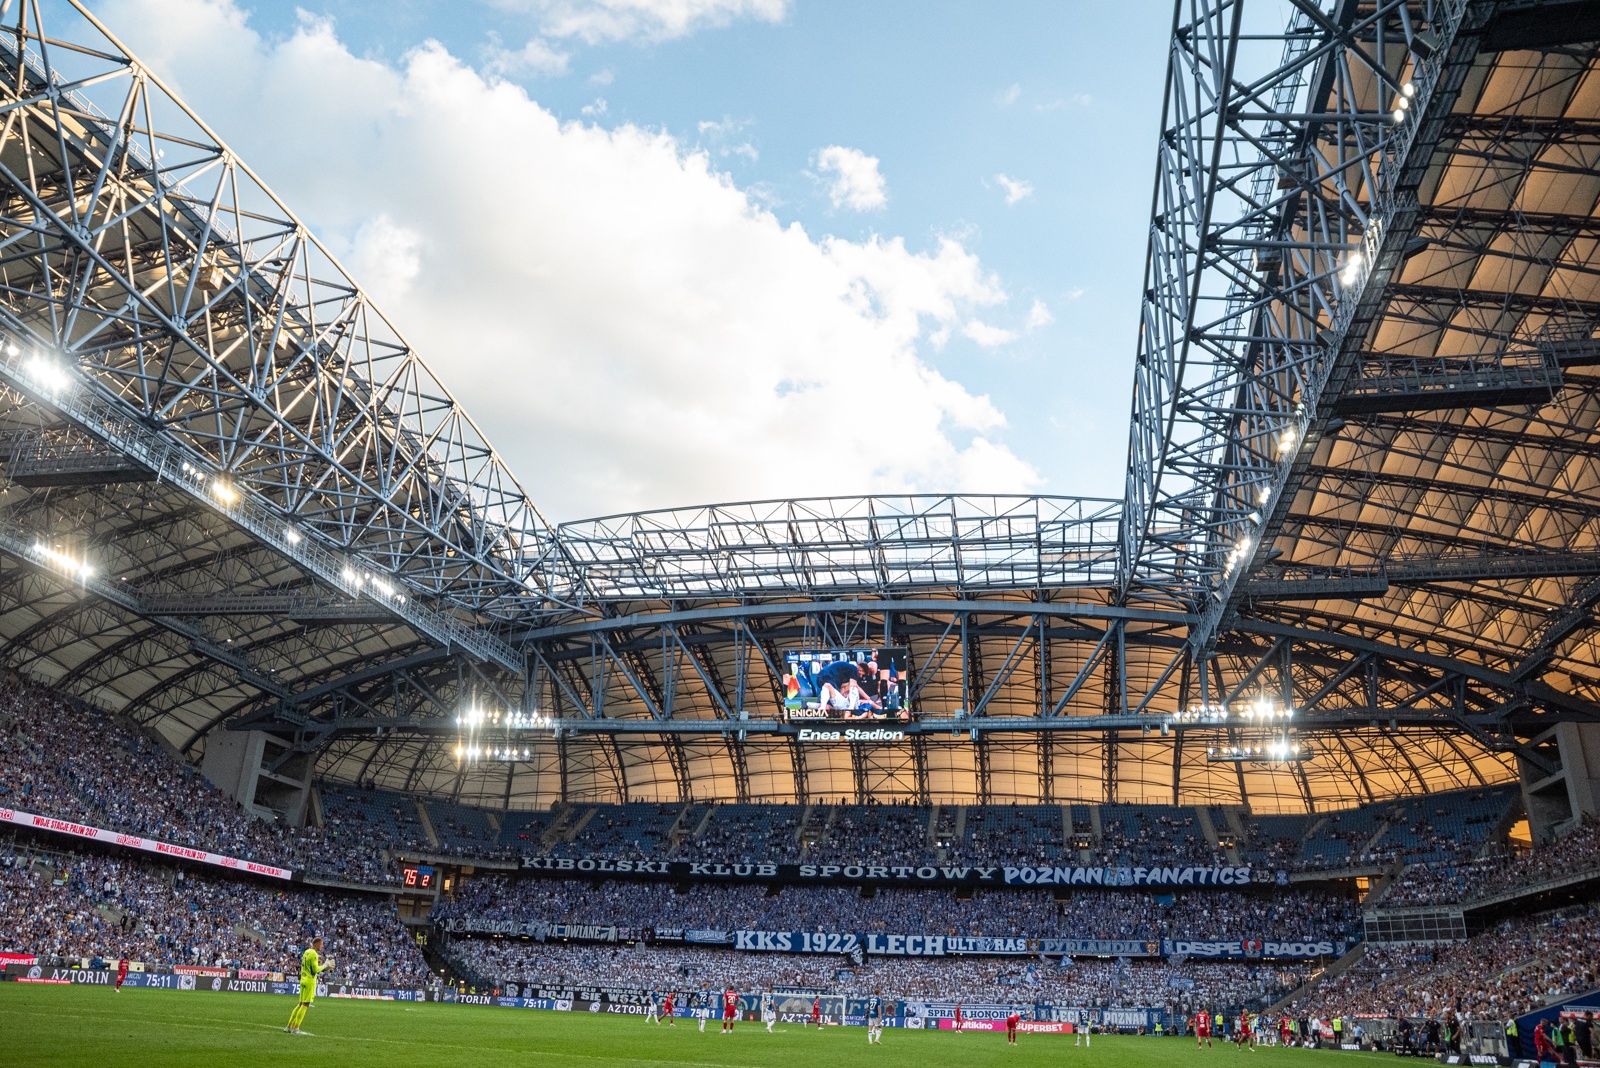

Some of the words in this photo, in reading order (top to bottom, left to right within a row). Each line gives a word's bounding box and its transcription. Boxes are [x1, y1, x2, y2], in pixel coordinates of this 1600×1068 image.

[790, 709, 828, 717] ENIGMA
[798, 729, 840, 740] Enea
[844, 729, 902, 740] Stadion
[86, 828, 98, 837] 24/7
[522, 856, 672, 873] KIBOLSKI
[689, 862, 778, 878] KLUB
[800, 864, 997, 880] SPORTOWY
[404, 868, 418, 885] 75
[422, 875, 430, 887] 2
[1003, 866, 1103, 884] POZNAN
[1133, 866, 1253, 885] FANATICS
[736, 930, 792, 952] KKS
[802, 932, 857, 953] 1922
[867, 934, 945, 955] LECH
[1044, 939, 1142, 954] PYRLANDIA
[1176, 942, 1241, 955] DESPE
[1264, 941, 1334, 956] RADOS
[52, 968, 109, 984] AZTORIN
[146, 974, 170, 988] 75:11
[228, 980, 267, 992] AZTORIN
[351, 987, 380, 996] AZTORIN
[398, 991, 412, 1000] 75:11
[460, 995, 491, 1005] TORIN
[728, 996, 736, 1004] 20
[523, 998, 547, 1009] 75:11
[690, 1008, 716, 1018] 7511
[781, 1013, 832, 1023] AZTOIN
[928, 1010, 968, 1018] SPRAA
[881, 1017, 896, 1027] :11
[1016, 1022, 1063, 1032] SUPERBET
